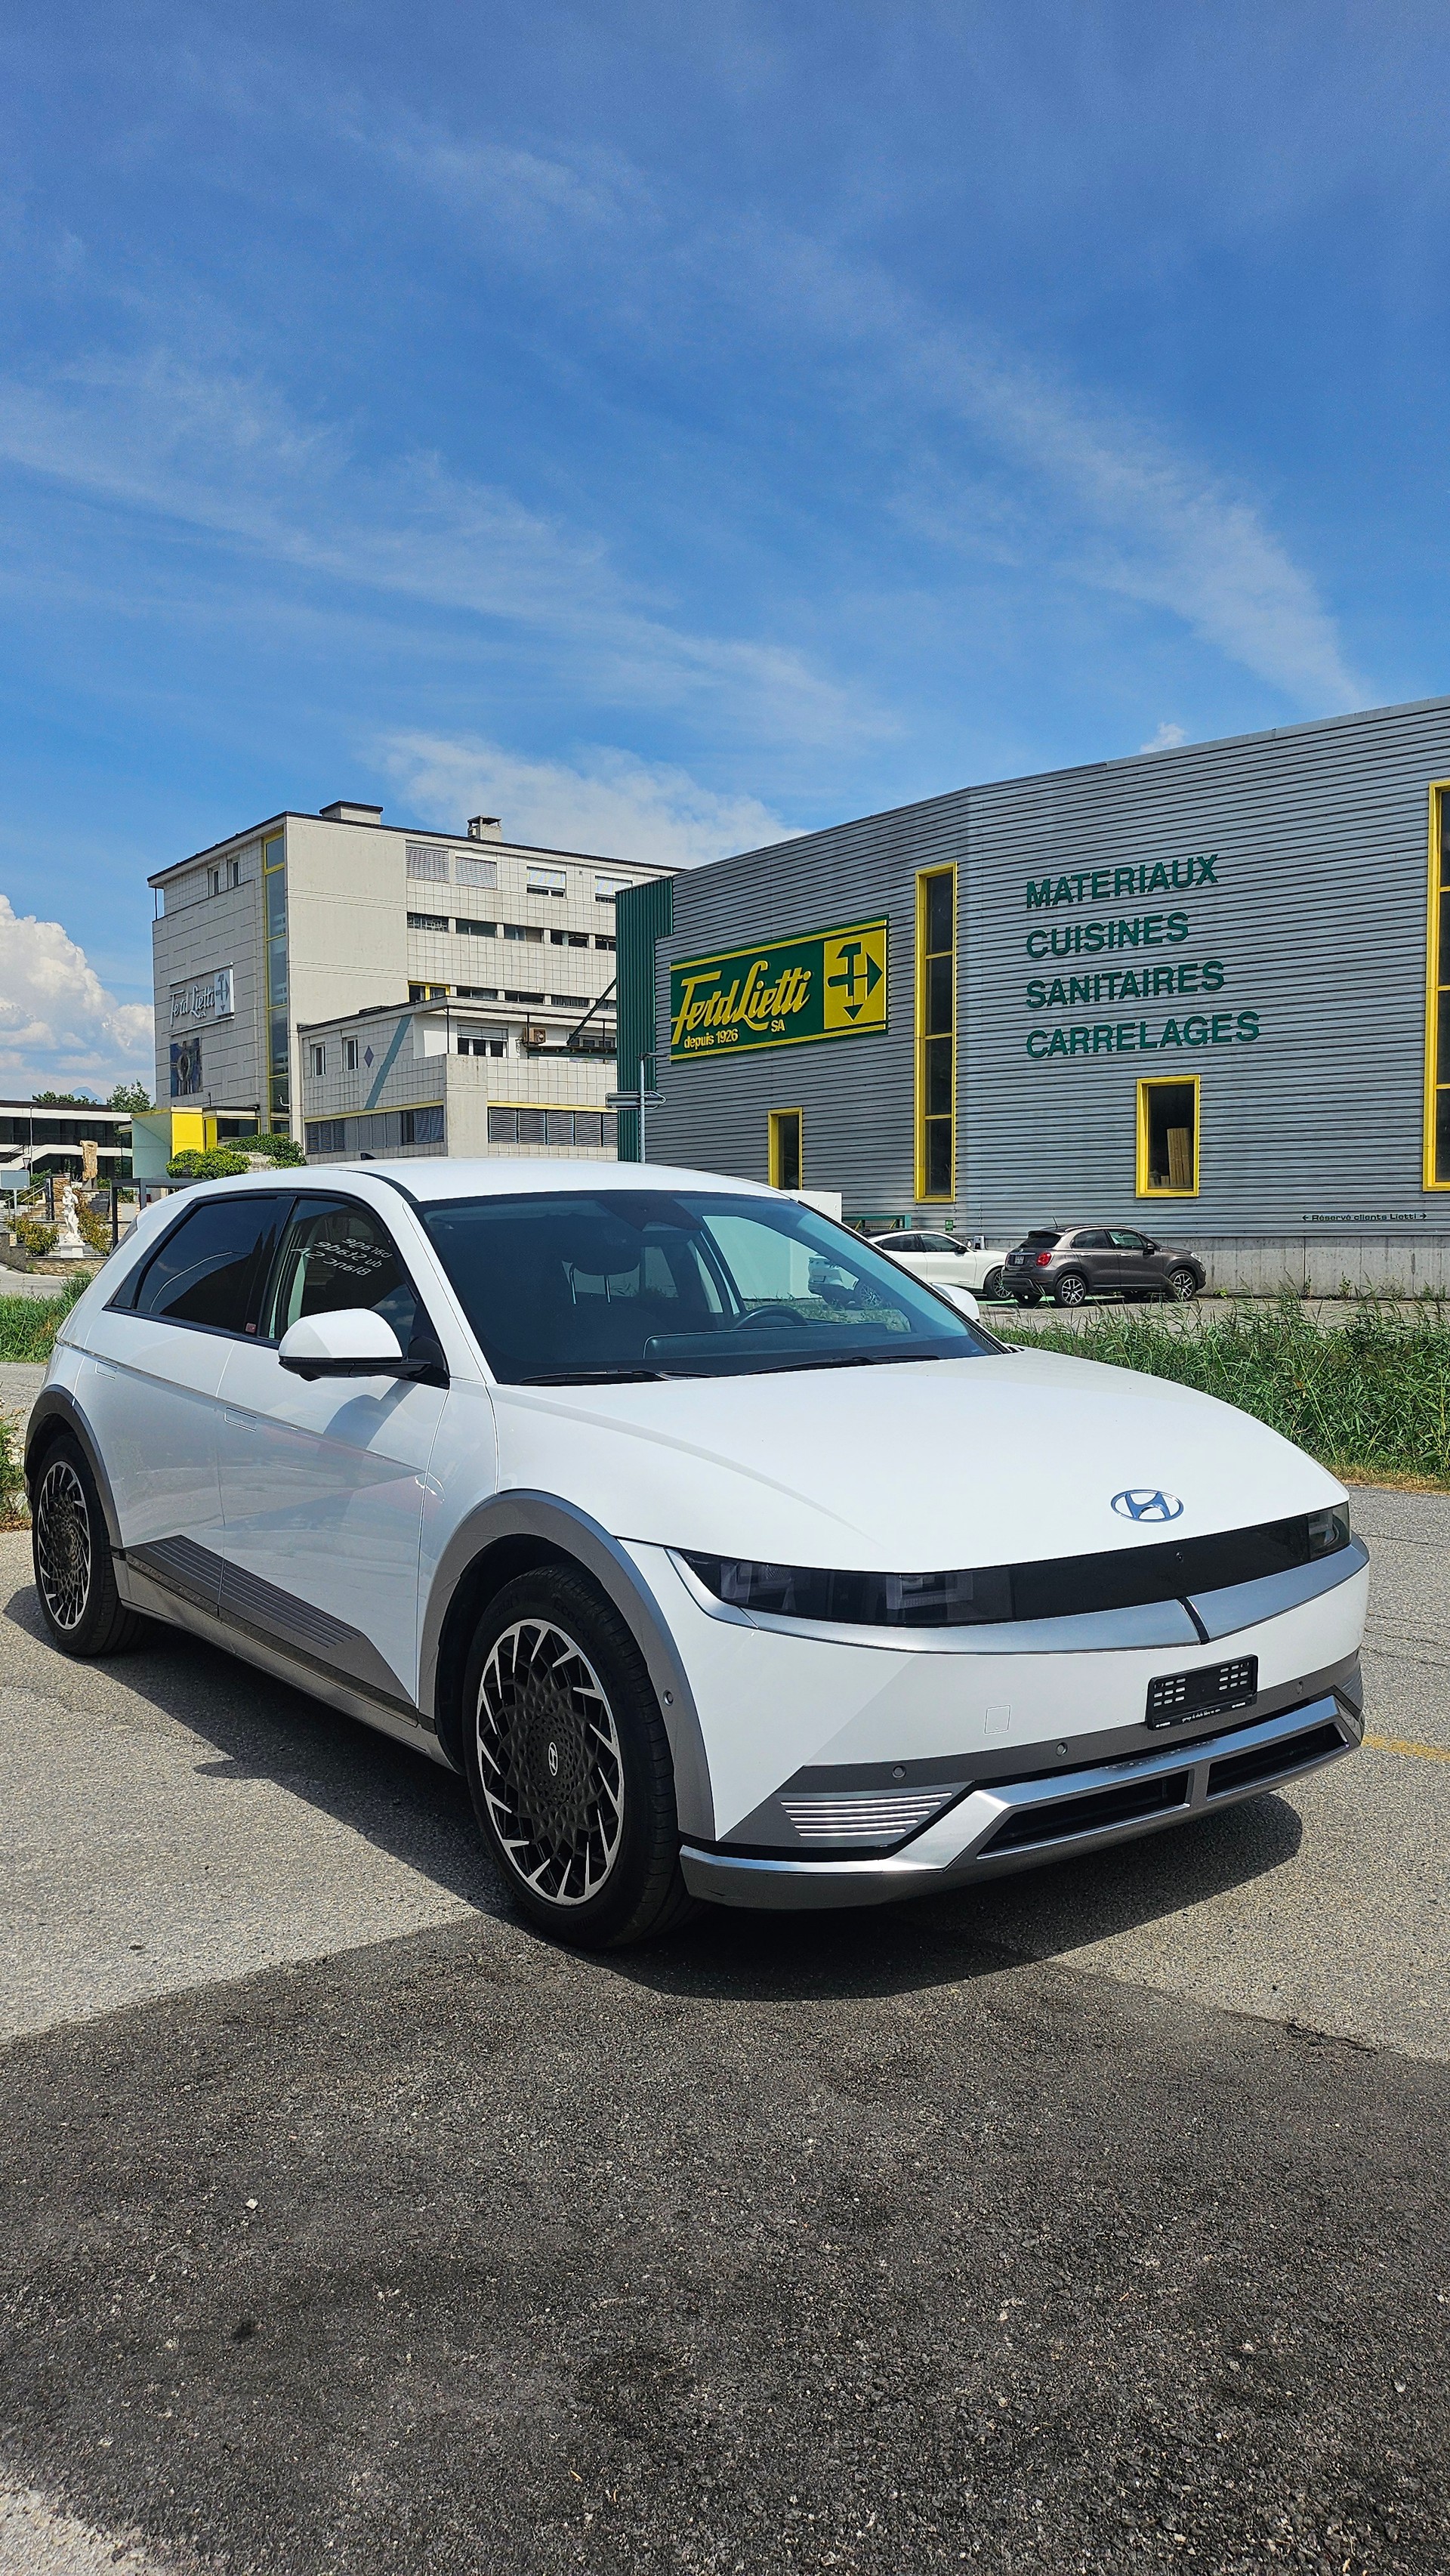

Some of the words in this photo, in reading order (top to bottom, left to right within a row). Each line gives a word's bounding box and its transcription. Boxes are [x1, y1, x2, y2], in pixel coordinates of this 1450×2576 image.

[1026, 854, 1218, 908] MATERIAUX
[1026, 912, 1189, 959] CUISINES
[732, 960, 812, 1031] Lietti
[1026, 961, 1224, 1008] SANITAIRES
[683, 1032, 714, 1050] depuis
[716, 1028, 739, 1043] 1926
[771, 1019, 785, 1033] SA
[1026, 1011, 1260, 1058] CARRELAGES
